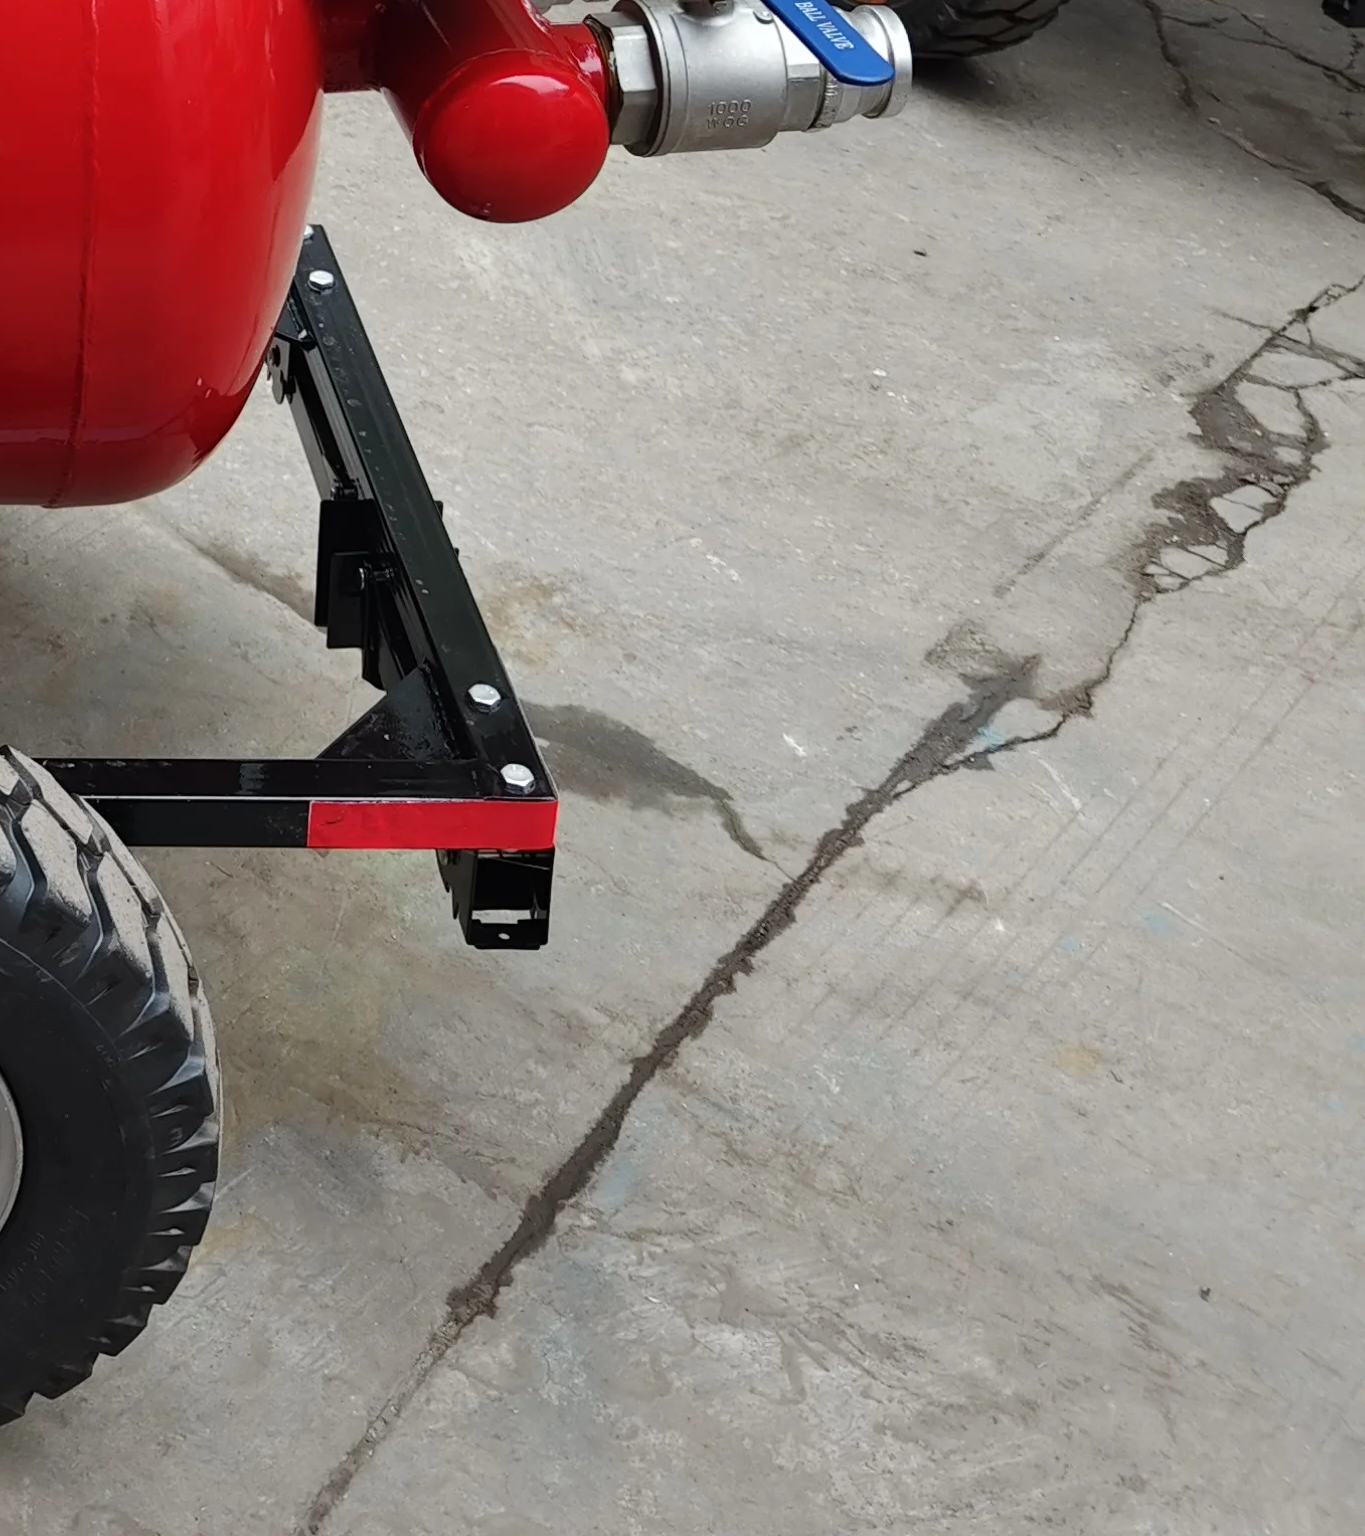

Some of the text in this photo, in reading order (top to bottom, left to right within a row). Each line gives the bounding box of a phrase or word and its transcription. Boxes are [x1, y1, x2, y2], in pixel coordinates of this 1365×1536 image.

[794, 1, 822, 22] BALL
[816, 21, 855, 50] VALVE
[707, 99, 752, 116] 1000
